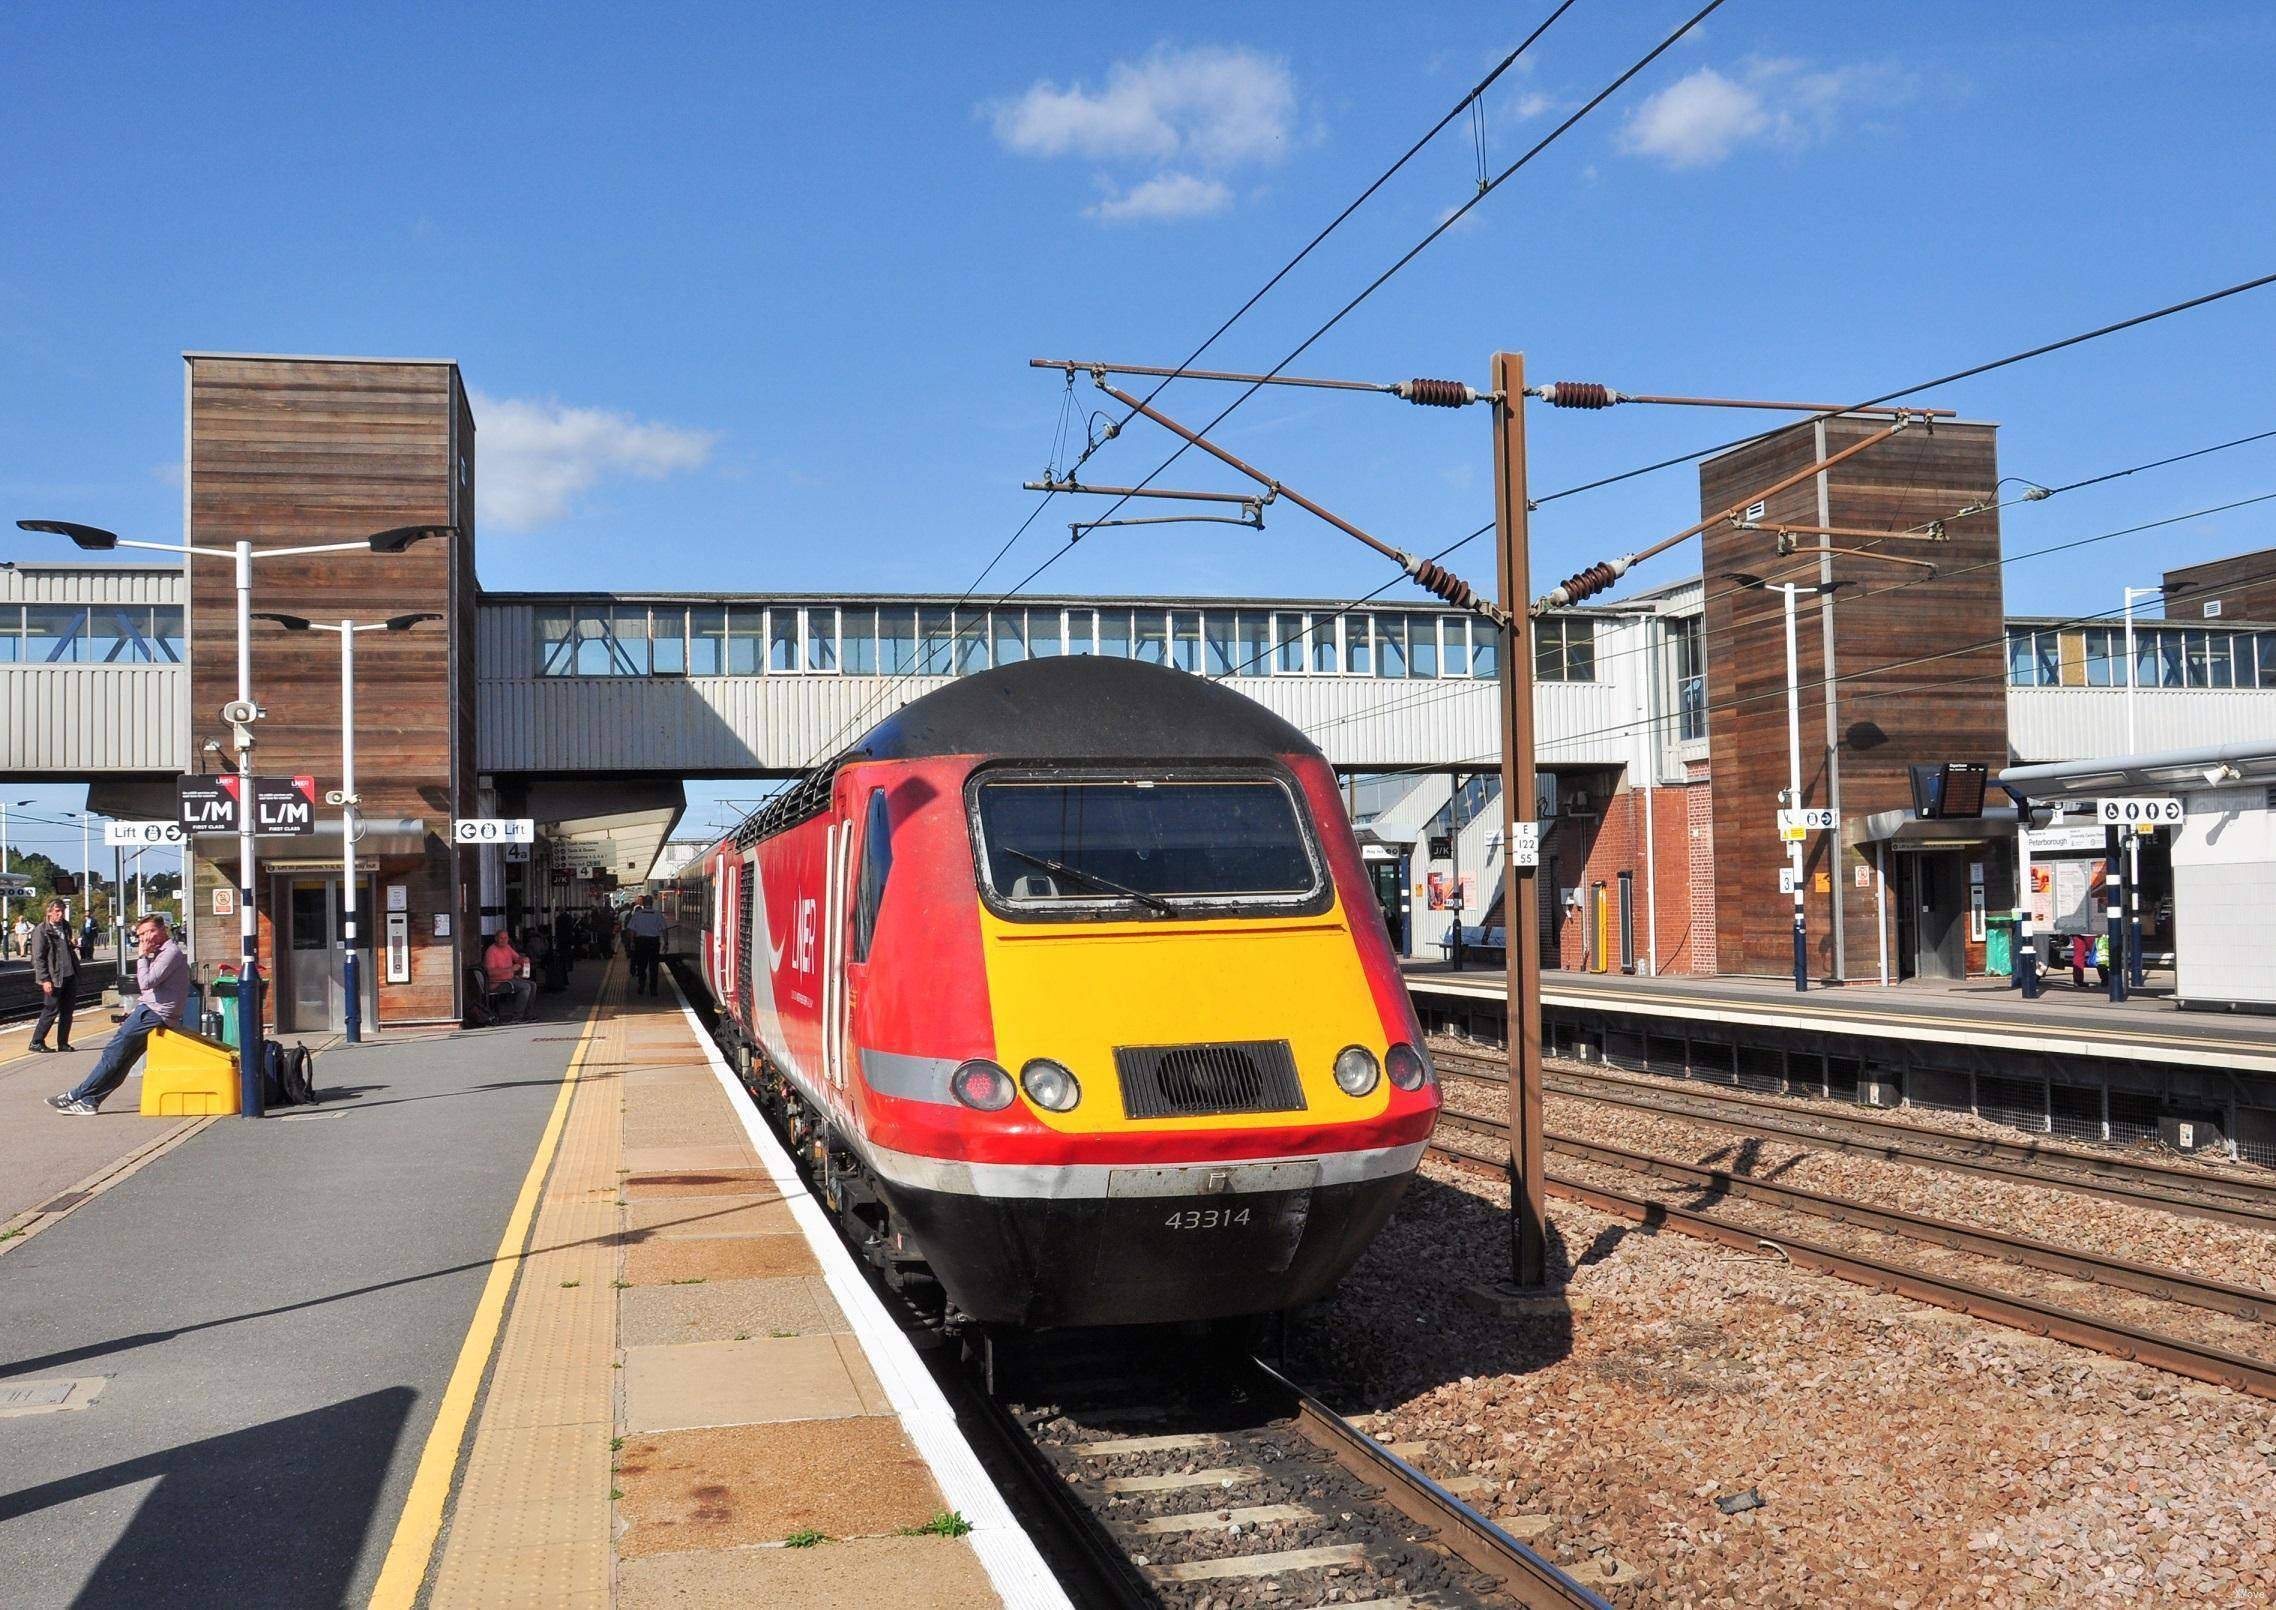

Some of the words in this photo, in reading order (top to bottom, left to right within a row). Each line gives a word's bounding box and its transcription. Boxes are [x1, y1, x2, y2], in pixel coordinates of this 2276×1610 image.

[184, 801, 233, 821] L/M
[260, 803, 308, 824] L/M
[114, 827, 137, 838] Lift
[504, 823, 525, 836] Lift
[1523, 825, 1529, 834] E
[1519, 840, 1535, 849] 122
[2028, 838, 2067, 847] Peterborough
[508, 844, 527, 859] 4a
[1433, 847, 1450, 855] J/K
[1520, 854, 1532, 864] 55
[581, 867, 589, 876] 4
[1784, 877, 1790, 890] 3
[791, 883, 816, 985] LNER
[1165, 1208, 1250, 1229] 43314
